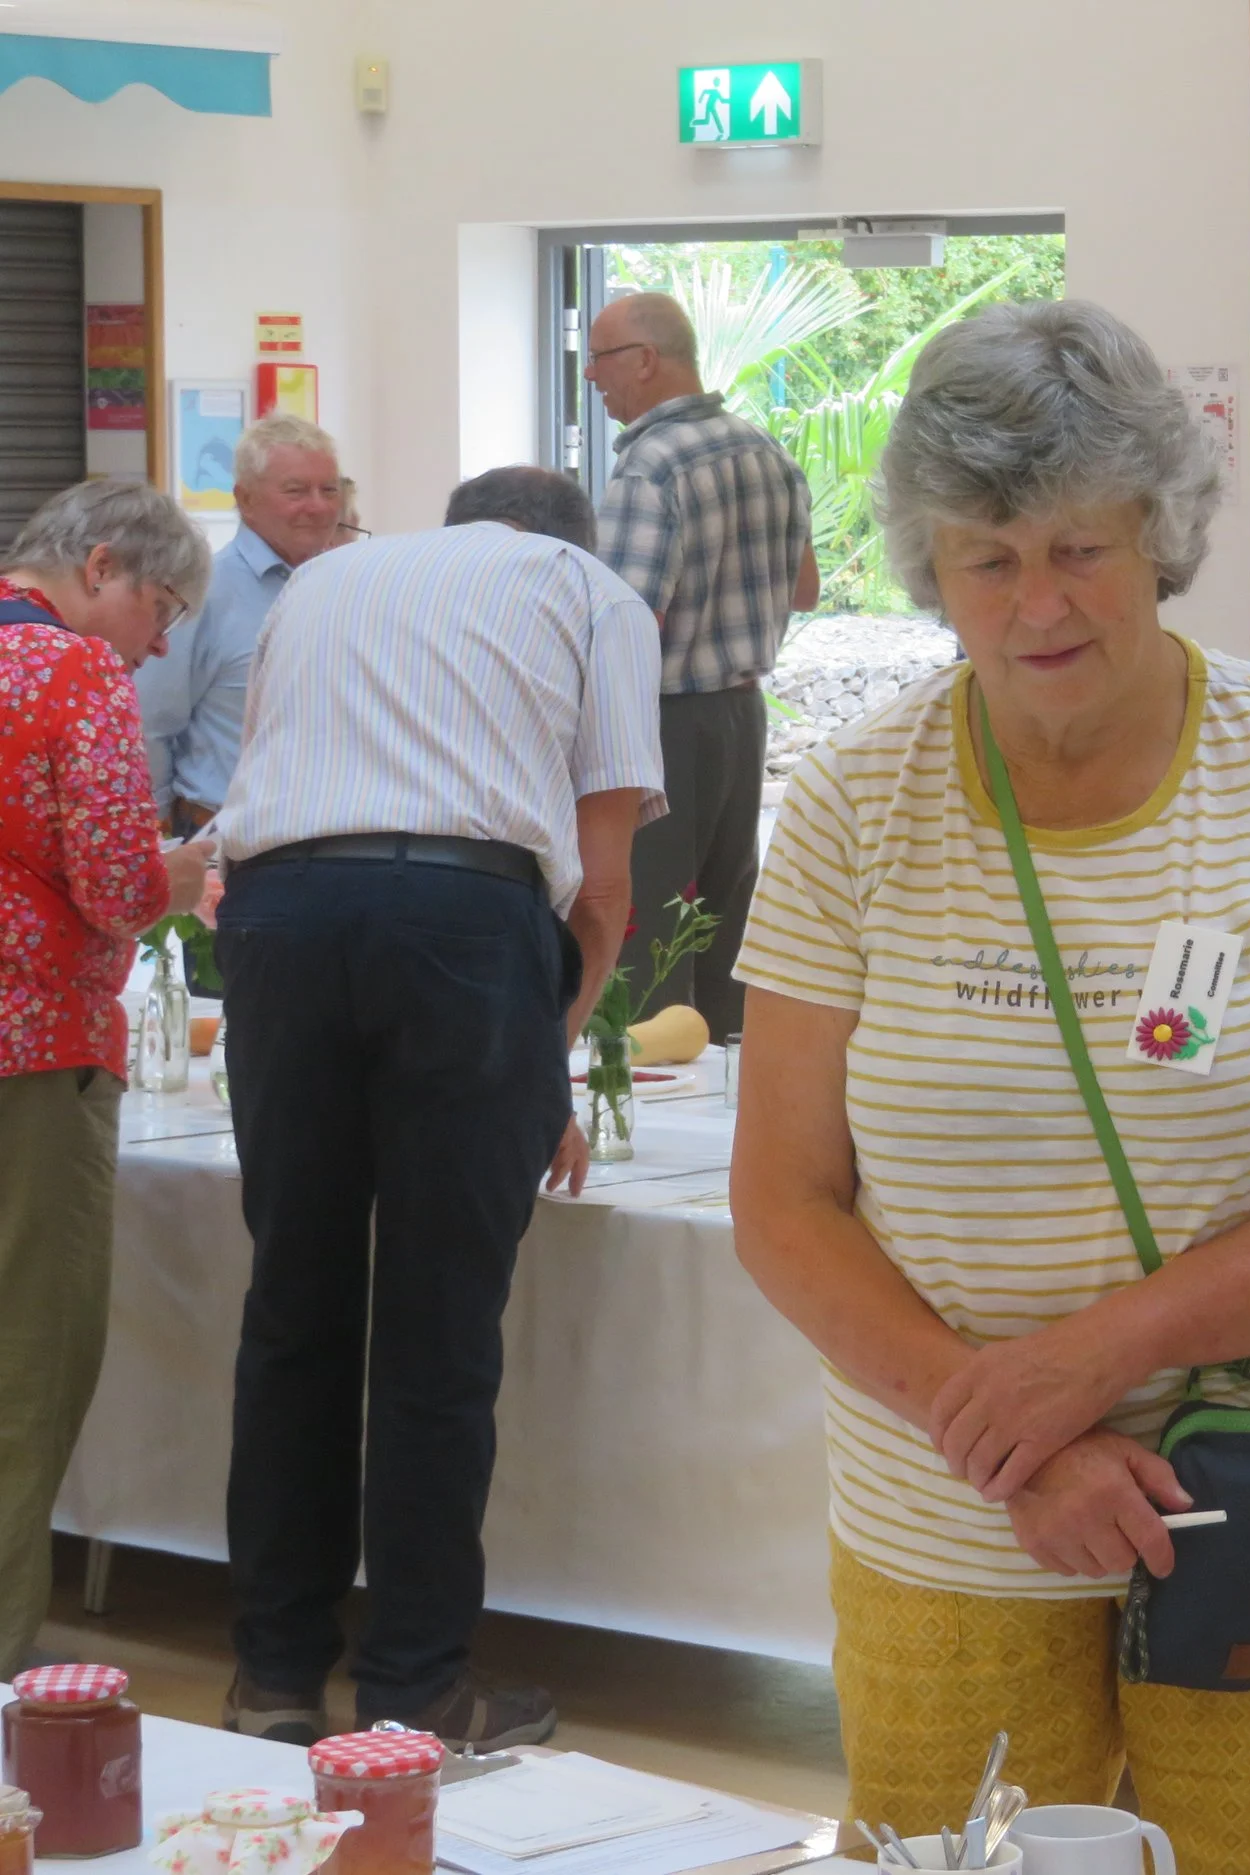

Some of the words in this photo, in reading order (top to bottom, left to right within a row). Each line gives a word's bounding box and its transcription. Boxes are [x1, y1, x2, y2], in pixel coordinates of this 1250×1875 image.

[931, 949, 1045, 980] endles
[1169, 938, 1195, 999] Rosemarie
[1207, 951, 1225, 998] Committee
[956, 981, 1121, 1010] wildflwer
